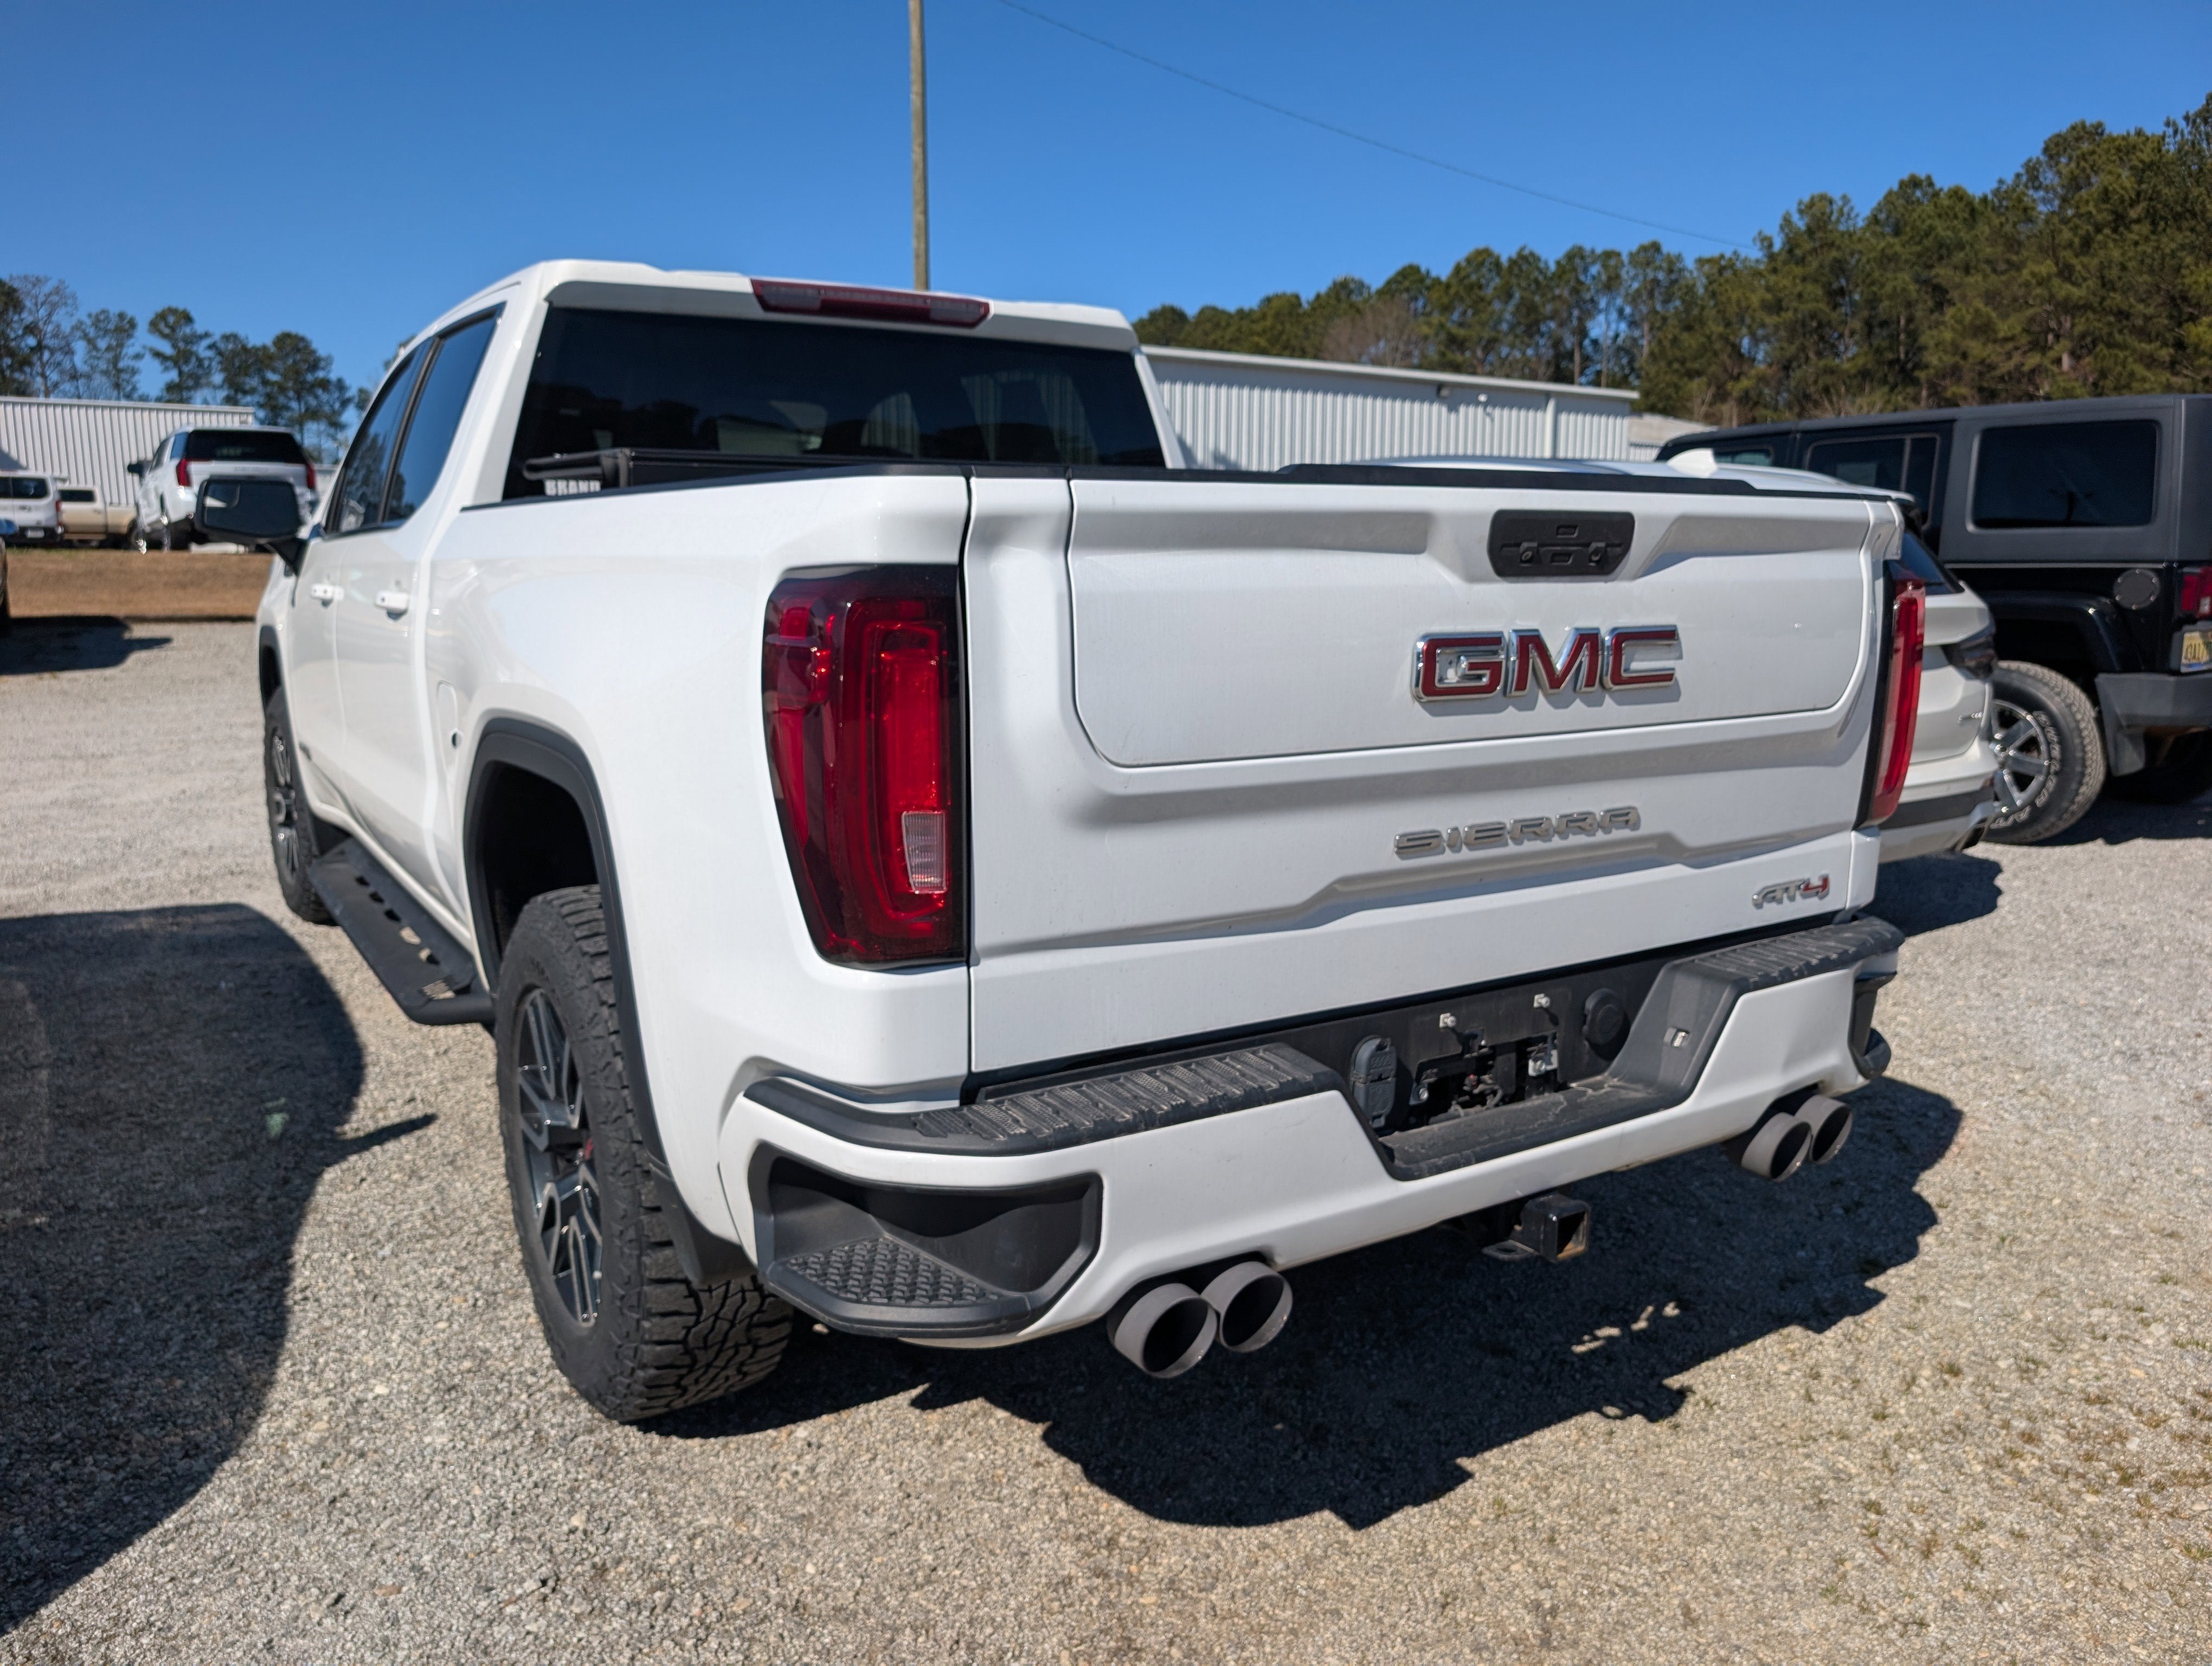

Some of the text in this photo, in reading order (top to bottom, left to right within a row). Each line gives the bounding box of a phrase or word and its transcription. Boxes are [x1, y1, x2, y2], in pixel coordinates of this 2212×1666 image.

[1412, 624, 1682, 702] GMC
[1395, 806, 1639, 855] SIERRA
[1752, 874, 1829, 909] AT4
